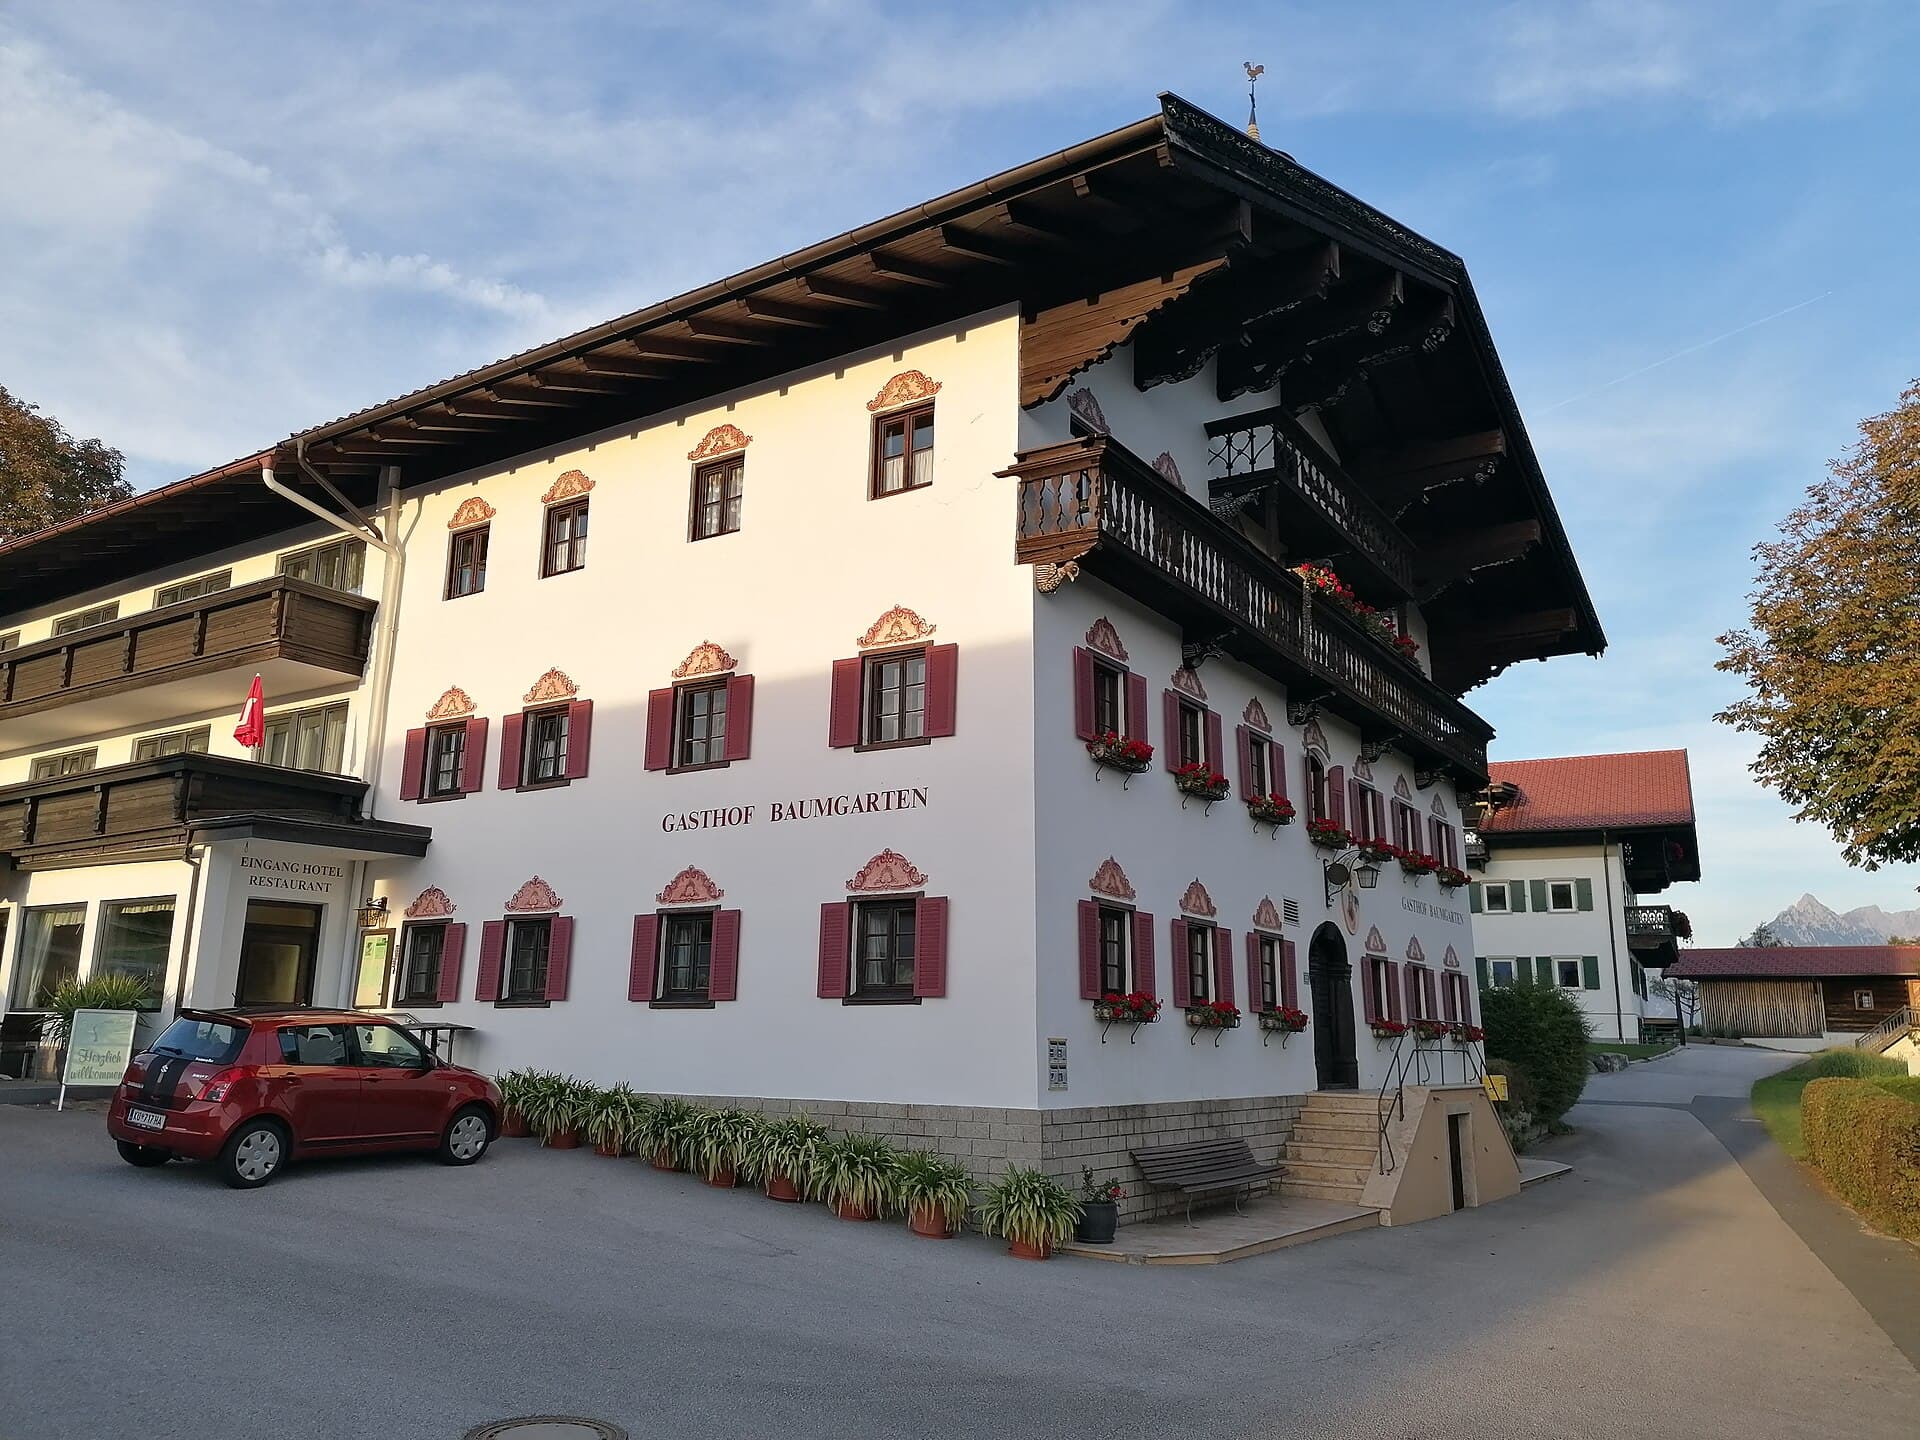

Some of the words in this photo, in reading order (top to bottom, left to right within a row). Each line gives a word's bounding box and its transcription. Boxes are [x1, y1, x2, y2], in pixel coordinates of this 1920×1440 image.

[662, 805, 755, 833] GASTHOF
[770, 786, 929, 822] BAUMGARTEN
[240, 856, 300, 874] EINGANG
[303, 864, 344, 878] HOTEL
[249, 875, 332, 893] RESTAURANT
[1401, 896, 1427, 916] GASTHOF
[79, 1048, 122, 1067] Herzlich
